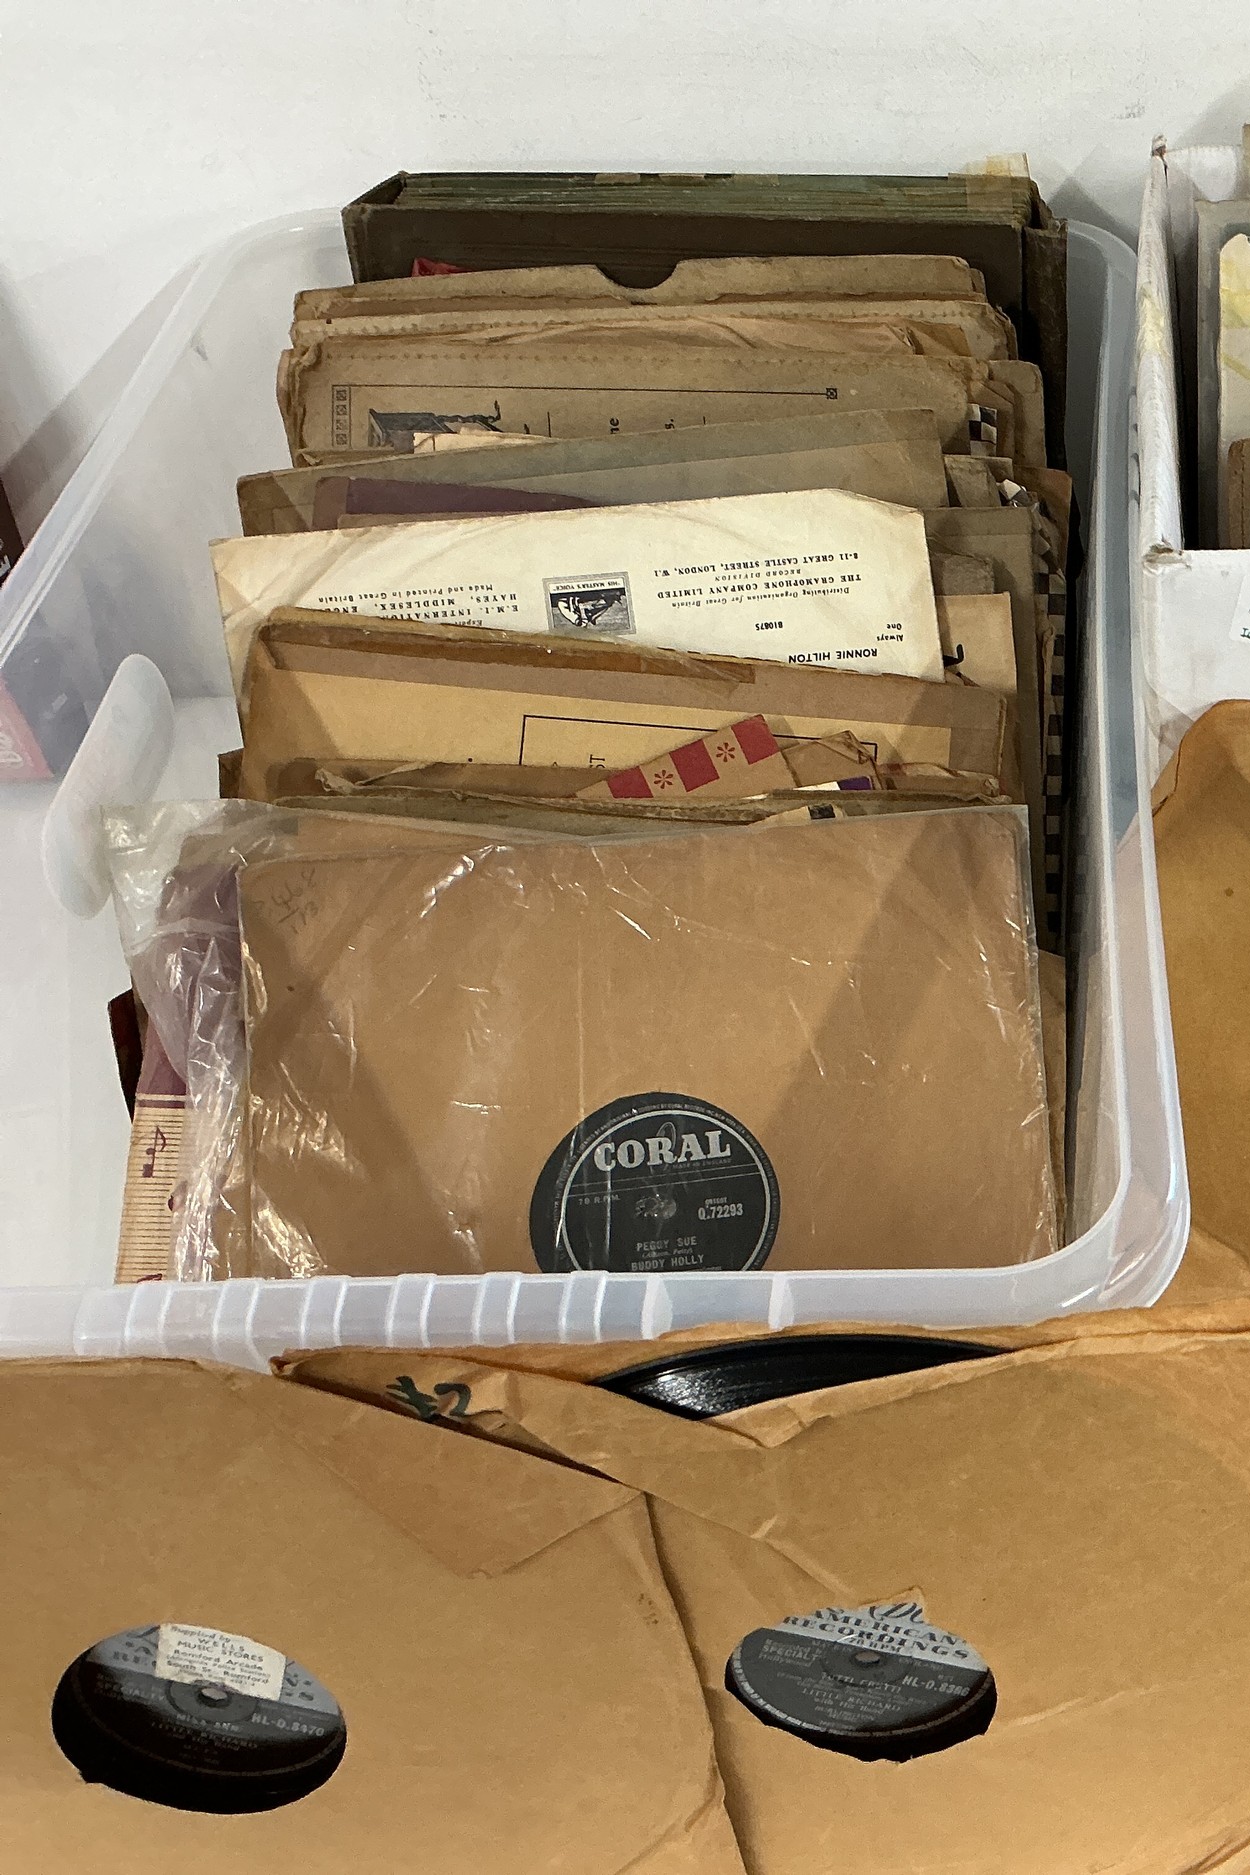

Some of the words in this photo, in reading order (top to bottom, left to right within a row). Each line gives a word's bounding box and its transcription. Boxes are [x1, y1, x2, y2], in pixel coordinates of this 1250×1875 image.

[763, 557, 799, 567] CASTLE
[801, 554, 835, 564] GREAT
[673, 564, 717, 575] LONDON,
[719, 561, 760, 571] STREET,
[713, 571, 761, 582] DIVISION
[765, 568, 802, 577] RECORD
[840, 573, 862, 583] THE
[468, 583, 493, 592] Made
[763, 575, 835, 590] GRAMOPHONE
[406, 587, 443, 598] Printed
[447, 586, 465, 595] and
[656, 588, 703, 600] LIMITED
[708, 582, 759, 595] COMPANY
[801, 587, 850, 596] Distributing
[318, 593, 354, 604] Britain
[358, 591, 387, 602] Great
[469, 592, 517, 604] HAYES,
[705, 597, 728, 606] Great
[730, 595, 744, 605] for
[373, 599, 456, 610] MIDDLESEX,
[479, 603, 519, 615] E.M.I.
[671, 599, 702, 609] Britain
[886, 622, 902, 630] One
[876, 633, 904, 642] Always
[788, 651, 832, 664] HILTON
[836, 648, 878, 660] RONNIE
[593, 1130, 731, 1172] CORAL
[698, 1203, 744, 1220] Q.72293
[636, 1240, 670, 1252] PEGGY
[677, 1236, 698, 1247] SUE
[631, 1259, 666, 1272] BUDDY
[671, 1254, 705, 1267] HOLLY
[783, 1615, 969, 1660] RECORDINGS
[198, 1637, 245, 1652] WELLS
[177, 1640, 214, 1653] MUSIC
[221, 1649, 264, 1663] STORES
[167, 1659, 197, 1671] South
[226, 1659, 263, 1671] Arcade
